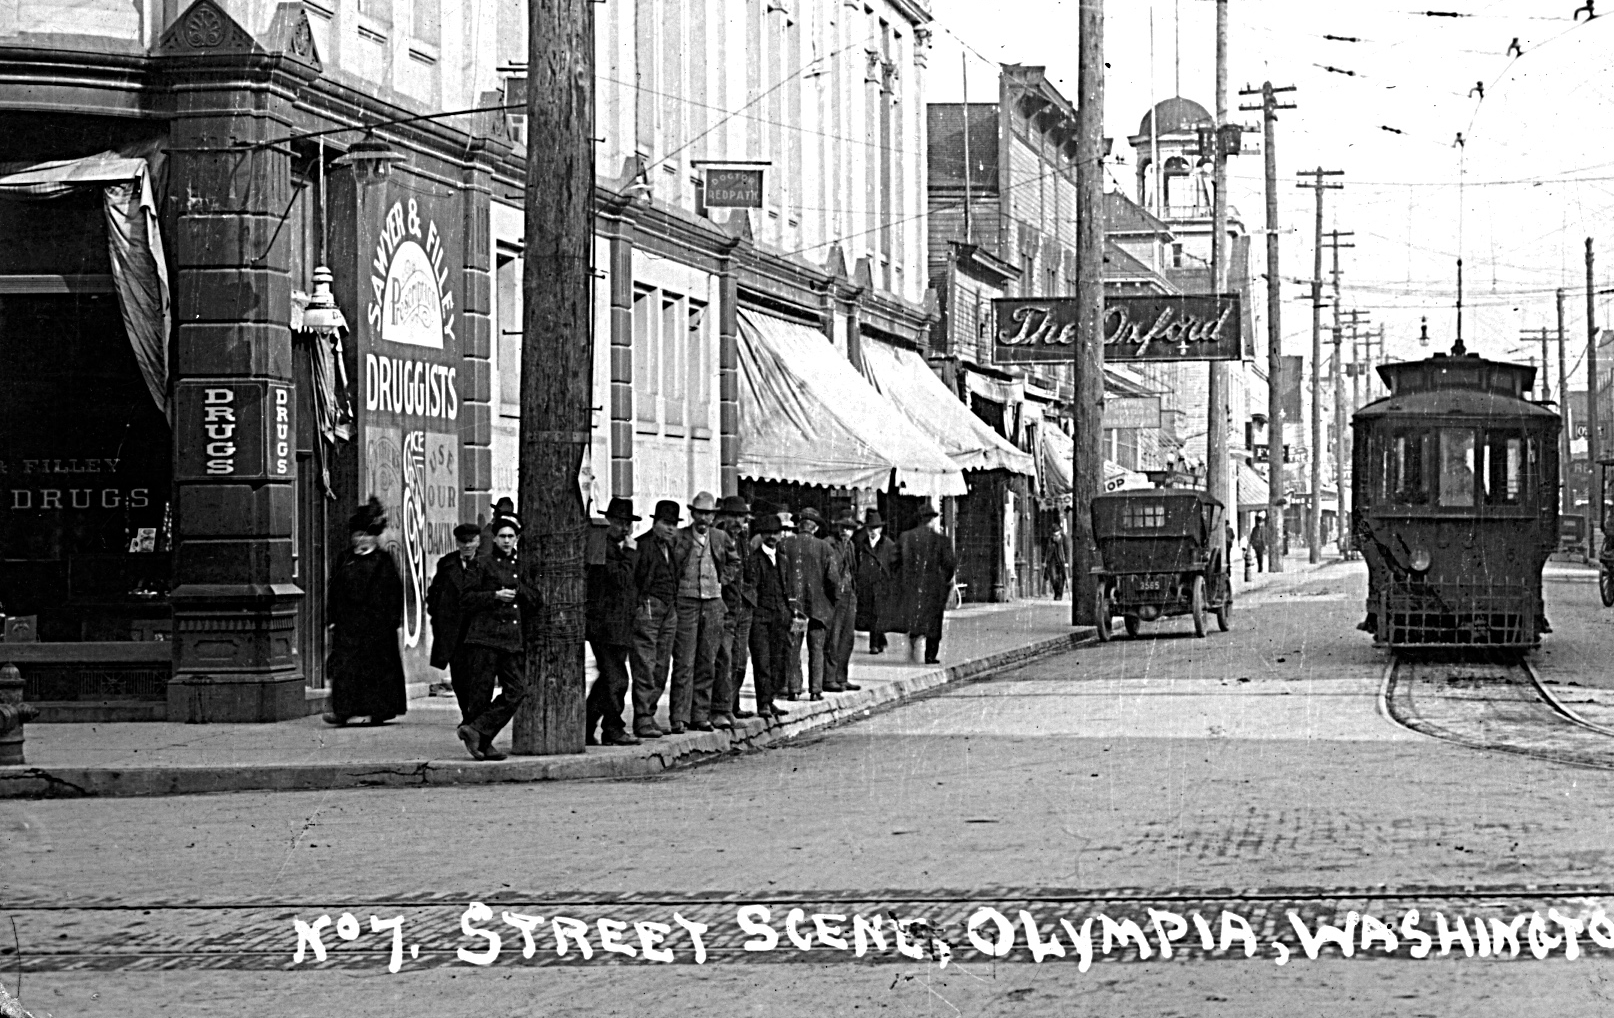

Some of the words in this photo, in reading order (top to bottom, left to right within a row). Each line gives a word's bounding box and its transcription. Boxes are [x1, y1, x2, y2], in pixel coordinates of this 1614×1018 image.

[708, 189, 759, 200] REDPATH
[368, 201, 406, 331] SAWYER
[408, 198, 421, 238] &
[426, 219, 456, 340] FILLEY
[999, 305, 1076, 345] The
[1103, 300, 1234, 357] Oxford
[366, 353, 458, 420] DRUGGISTS
[205, 388, 236, 474] DRUGS
[276, 388, 288, 474] DRUGS
[23, 458, 121, 473] FILLEY
[429, 444, 454, 475] USE
[11, 488, 149, 509] DRUGS
[428, 485, 456, 508] OUR
